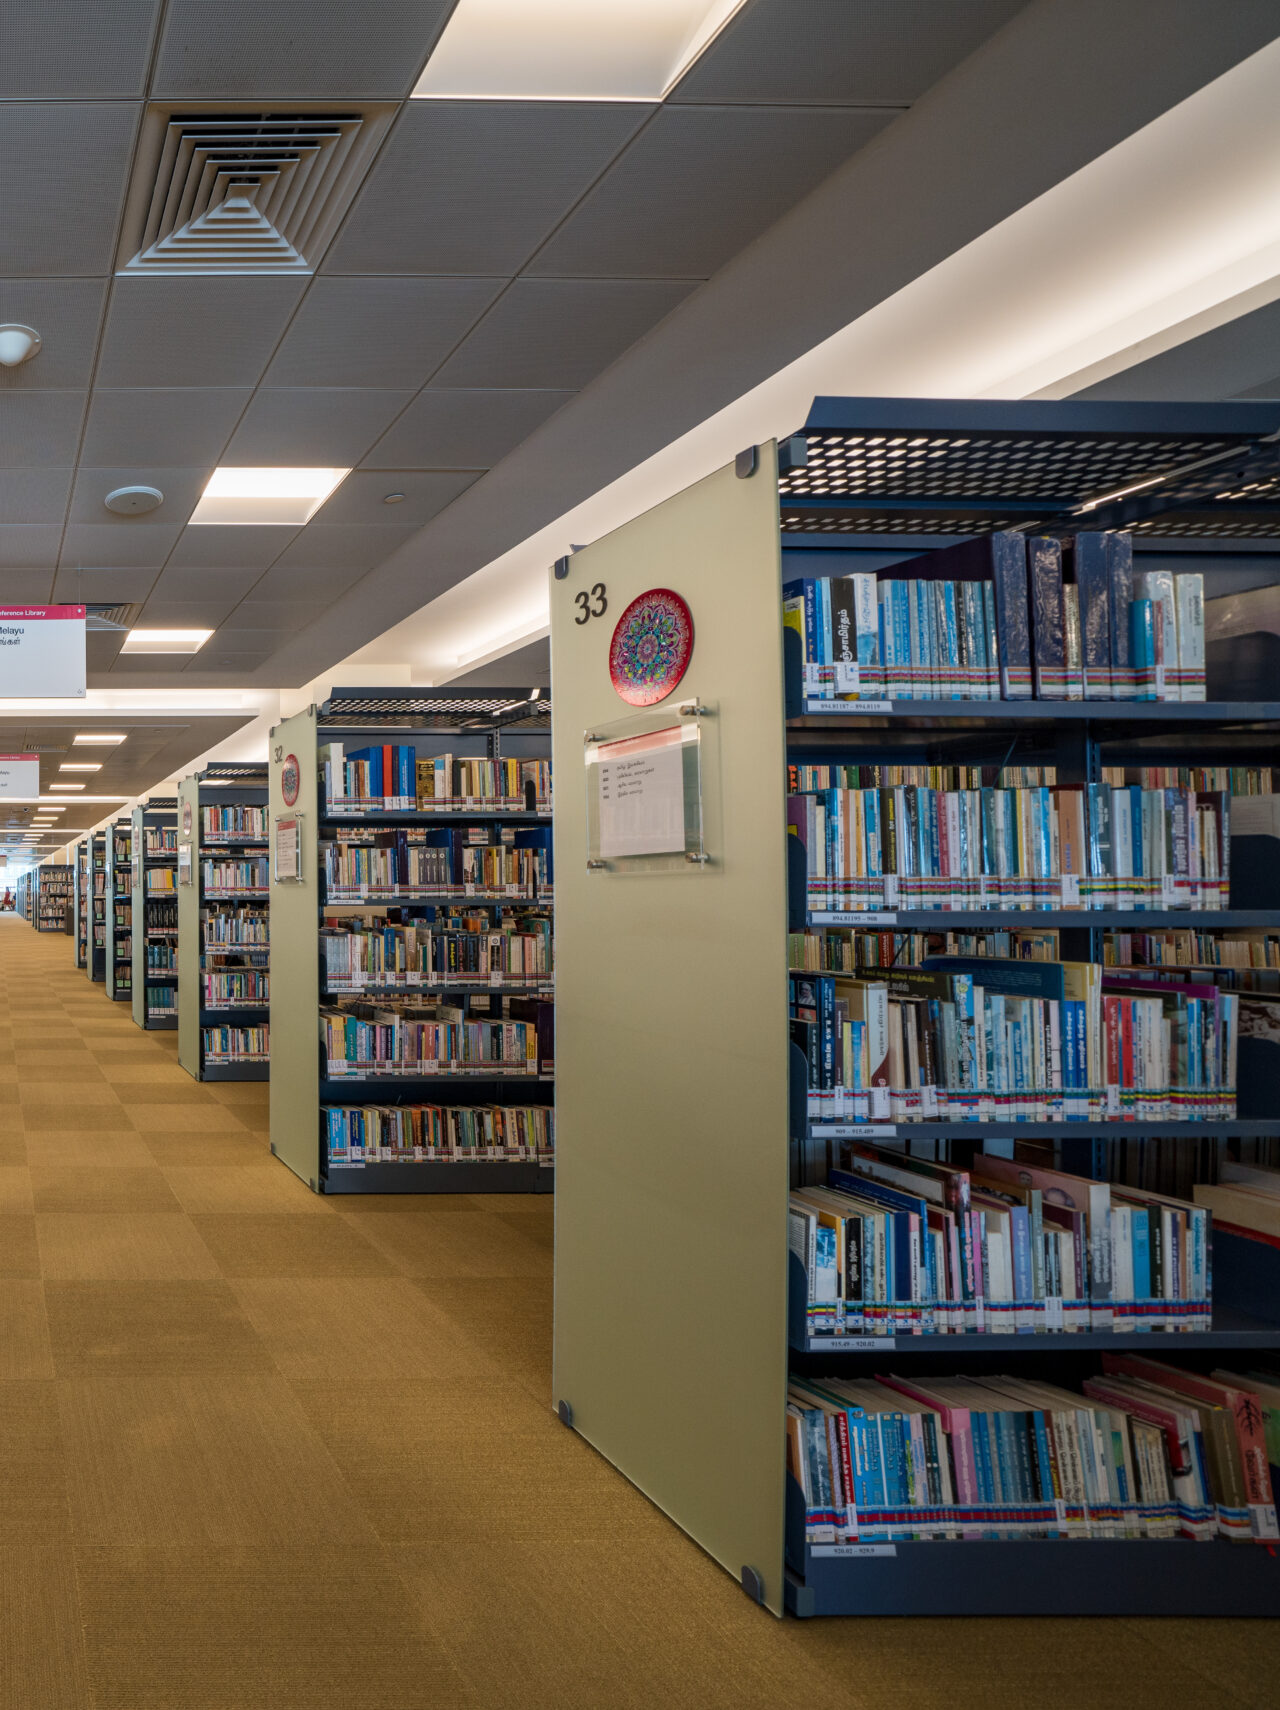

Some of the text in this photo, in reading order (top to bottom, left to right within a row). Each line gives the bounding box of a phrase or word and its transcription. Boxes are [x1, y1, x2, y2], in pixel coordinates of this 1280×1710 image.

[574, 583, 608, 625] 33
[274, 745, 283, 764] 32
[824, 1043, 832, 1070] வரலாறு
[1244, 1449, 1258, 1500] வேர்கள்
